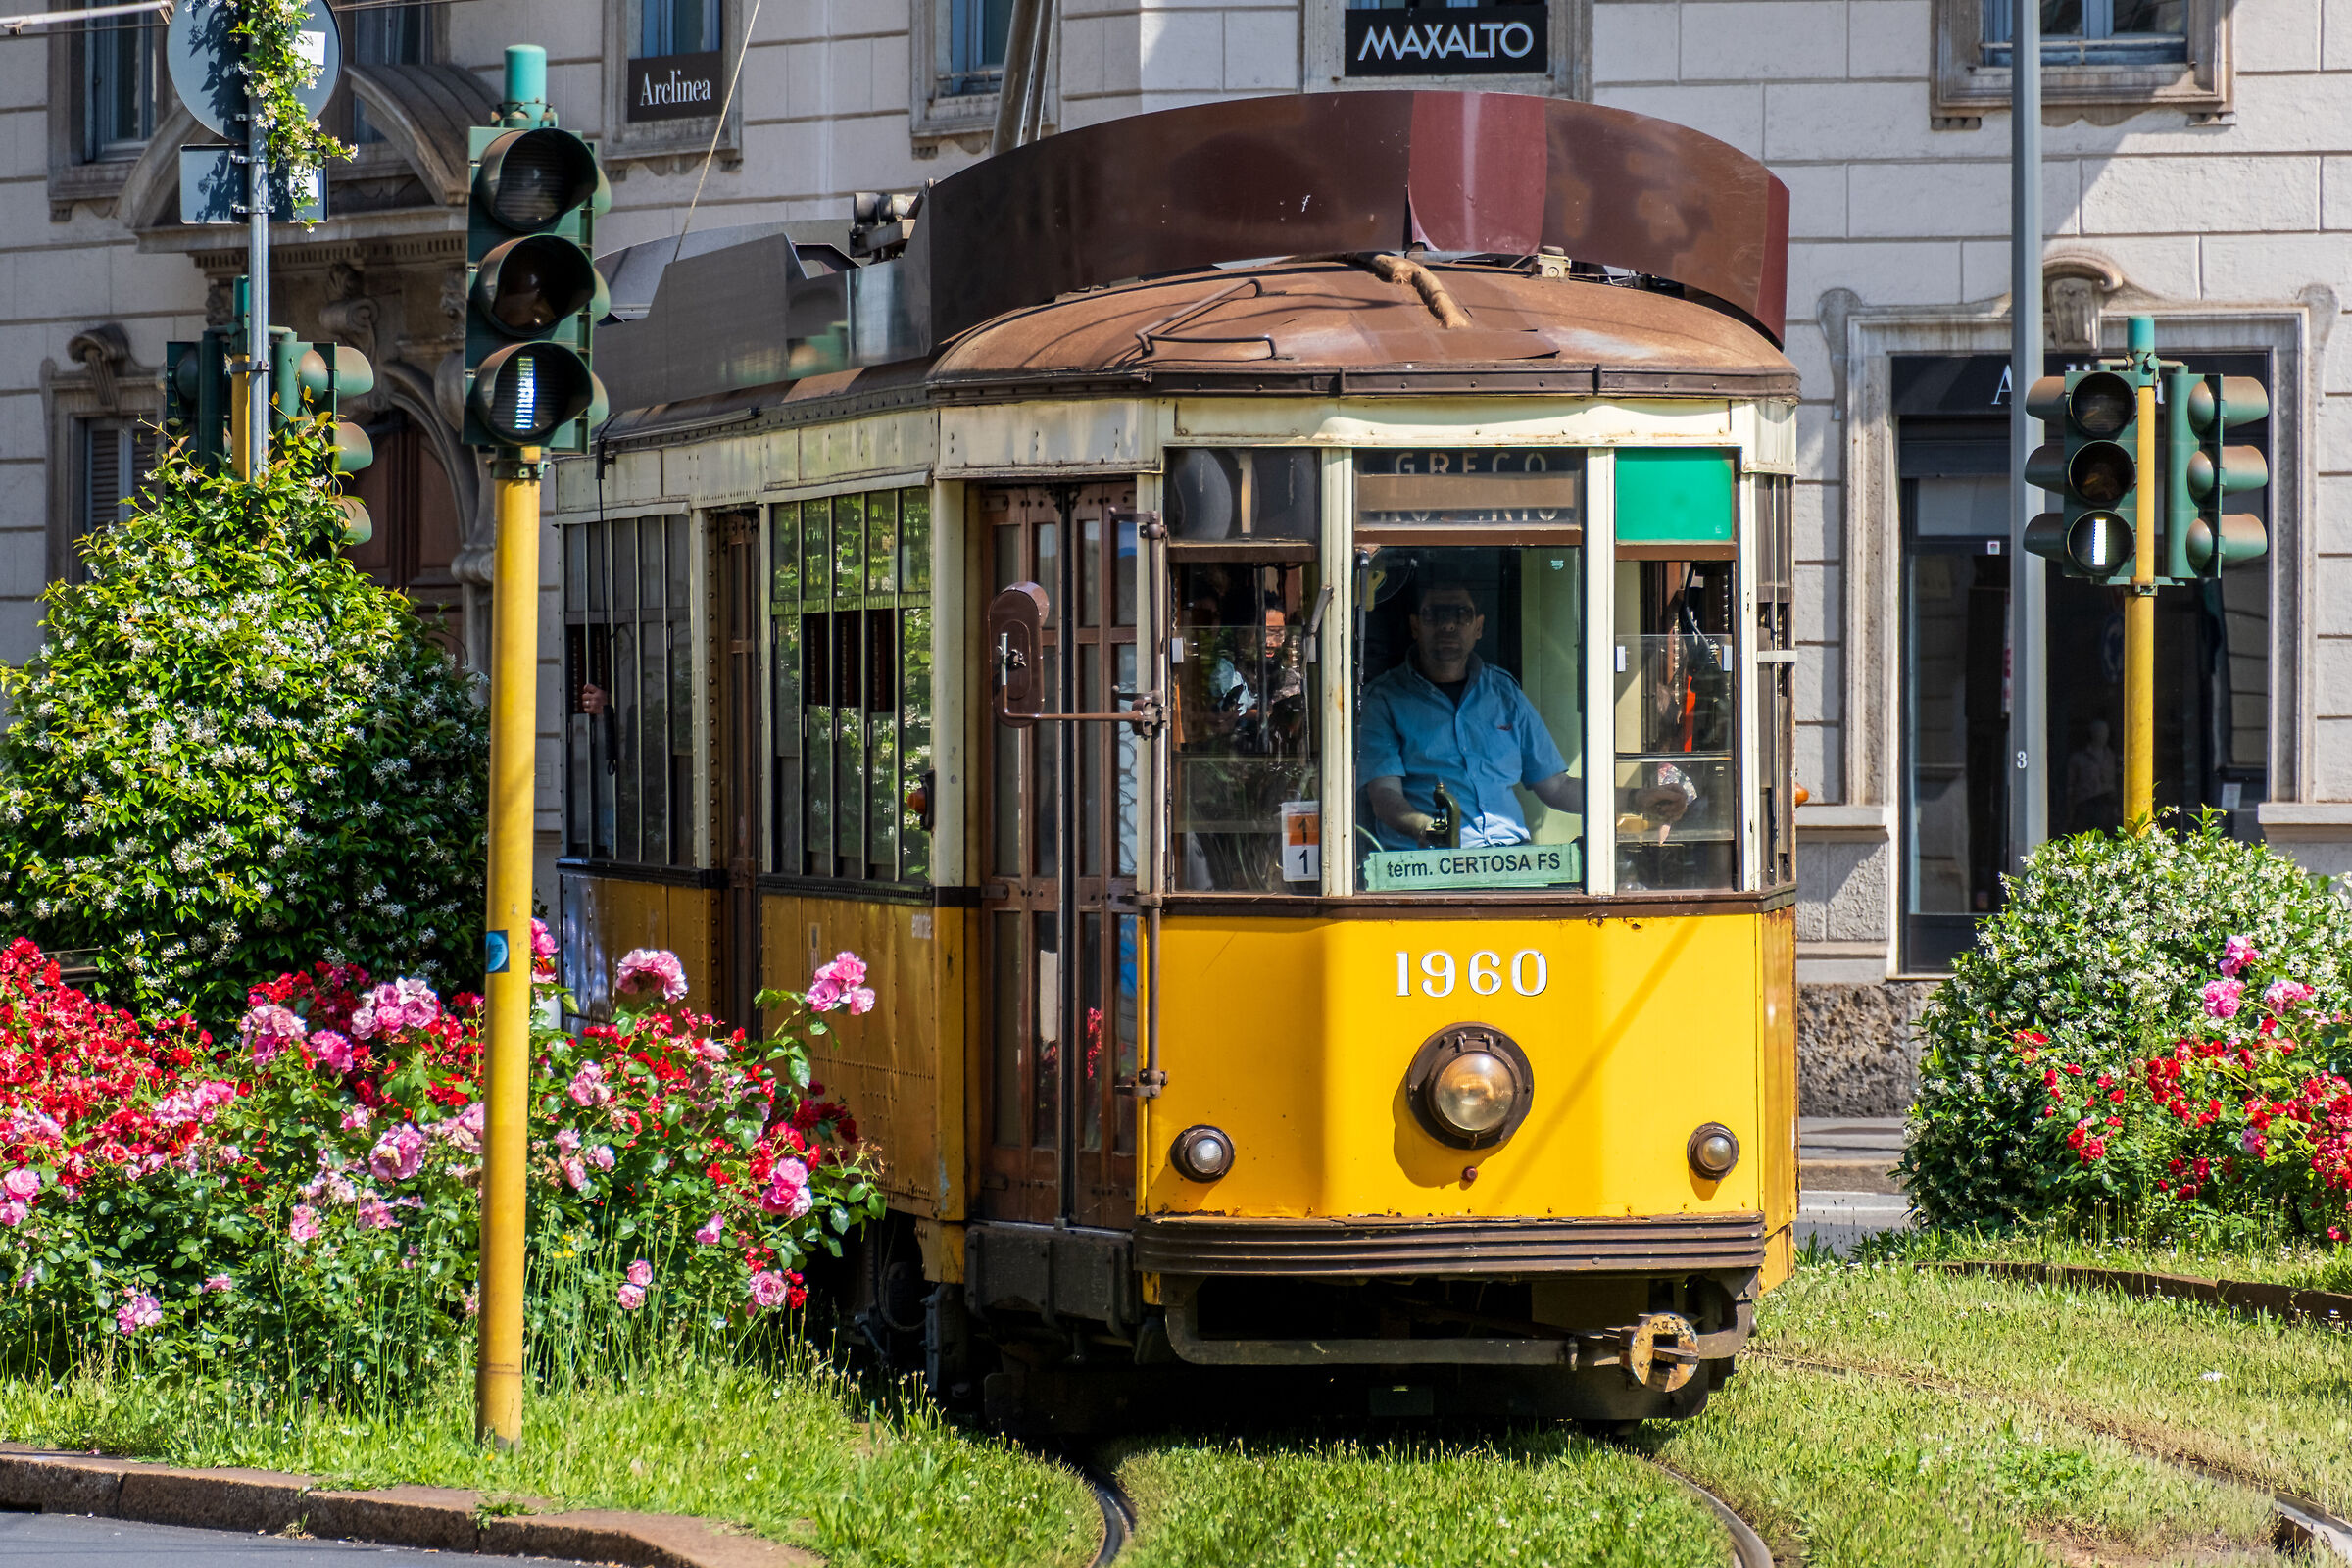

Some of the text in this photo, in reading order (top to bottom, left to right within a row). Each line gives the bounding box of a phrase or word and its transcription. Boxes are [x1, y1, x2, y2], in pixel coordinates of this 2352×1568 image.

[1357, 22, 1534, 61] MAXALTO
[639, 69, 711, 106] Arclinea
[2017, 750, 2028, 769] 3
[1299, 849, 1308, 874] 1
[1387, 852, 1561, 877] term. CERTOSA FS
[1396, 950, 1548, 998] 1960
